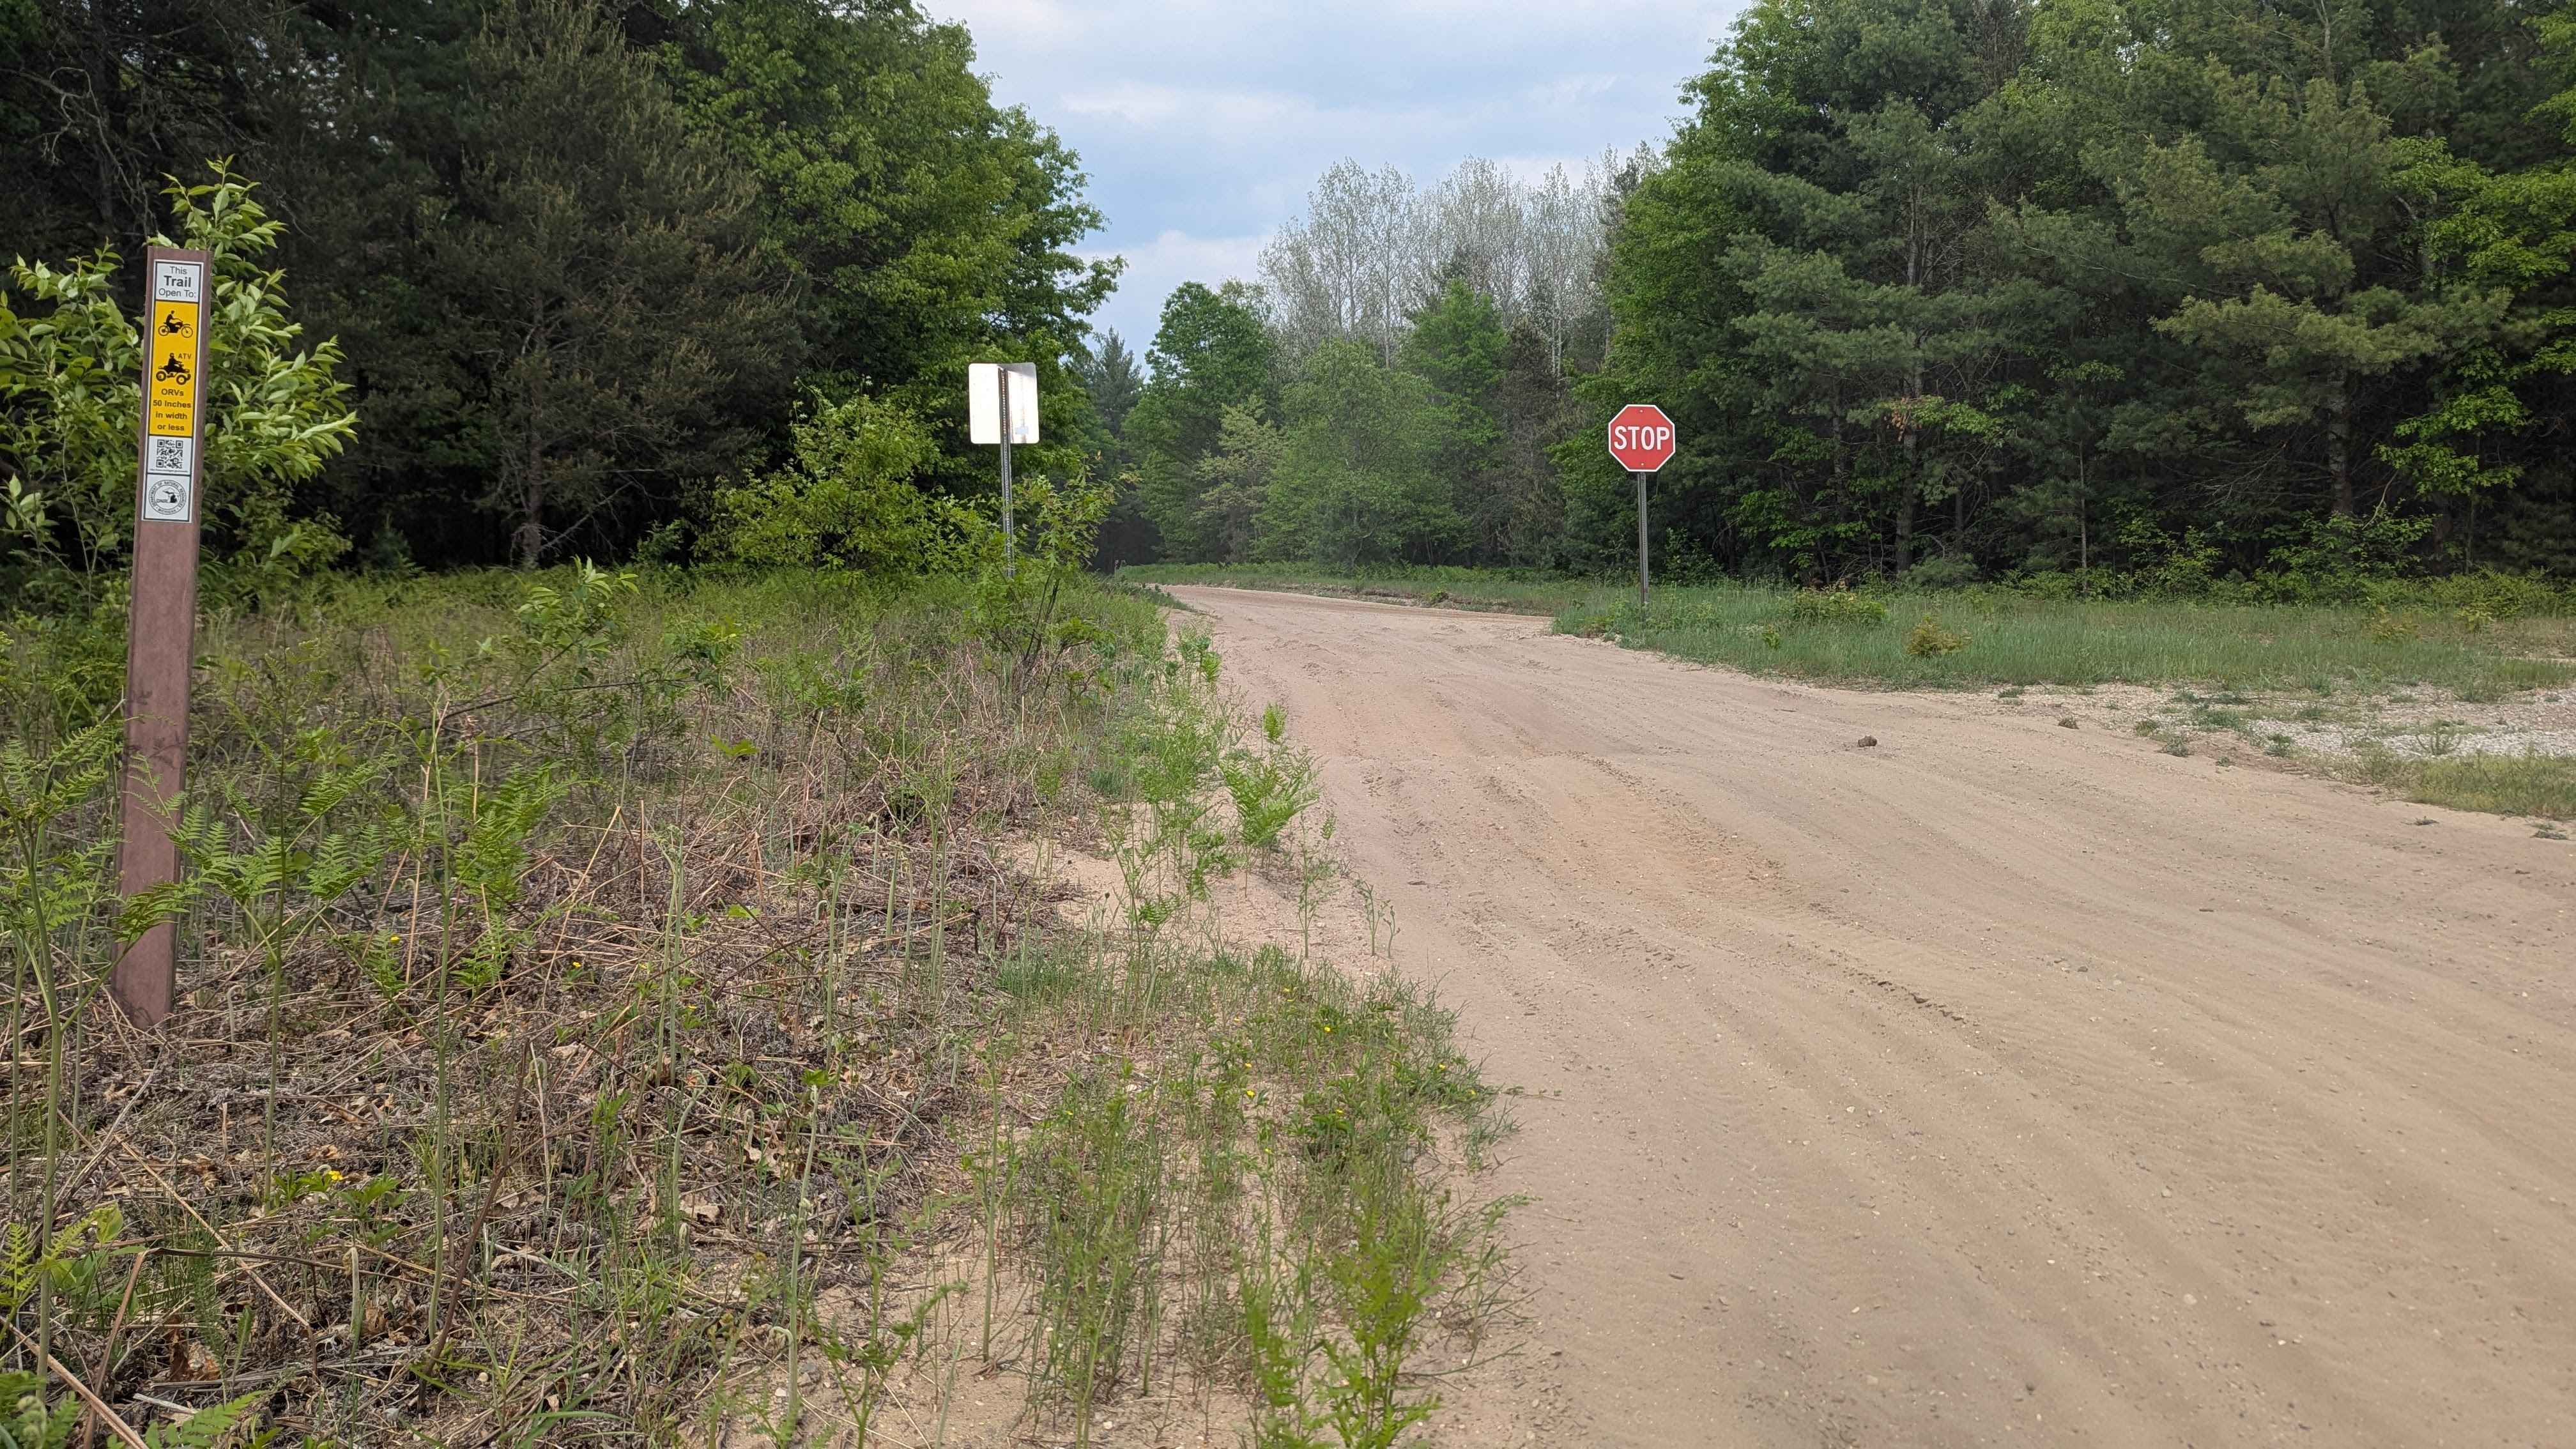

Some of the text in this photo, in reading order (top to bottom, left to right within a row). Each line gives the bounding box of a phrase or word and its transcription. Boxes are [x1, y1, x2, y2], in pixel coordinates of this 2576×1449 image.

[170, 266, 187, 275] This
[164, 275, 192, 288] Trail
[158, 288, 196, 298] Open To:
[161, 388, 184, 396] ORVs
[1614, 426, 1669, 450] STOP
